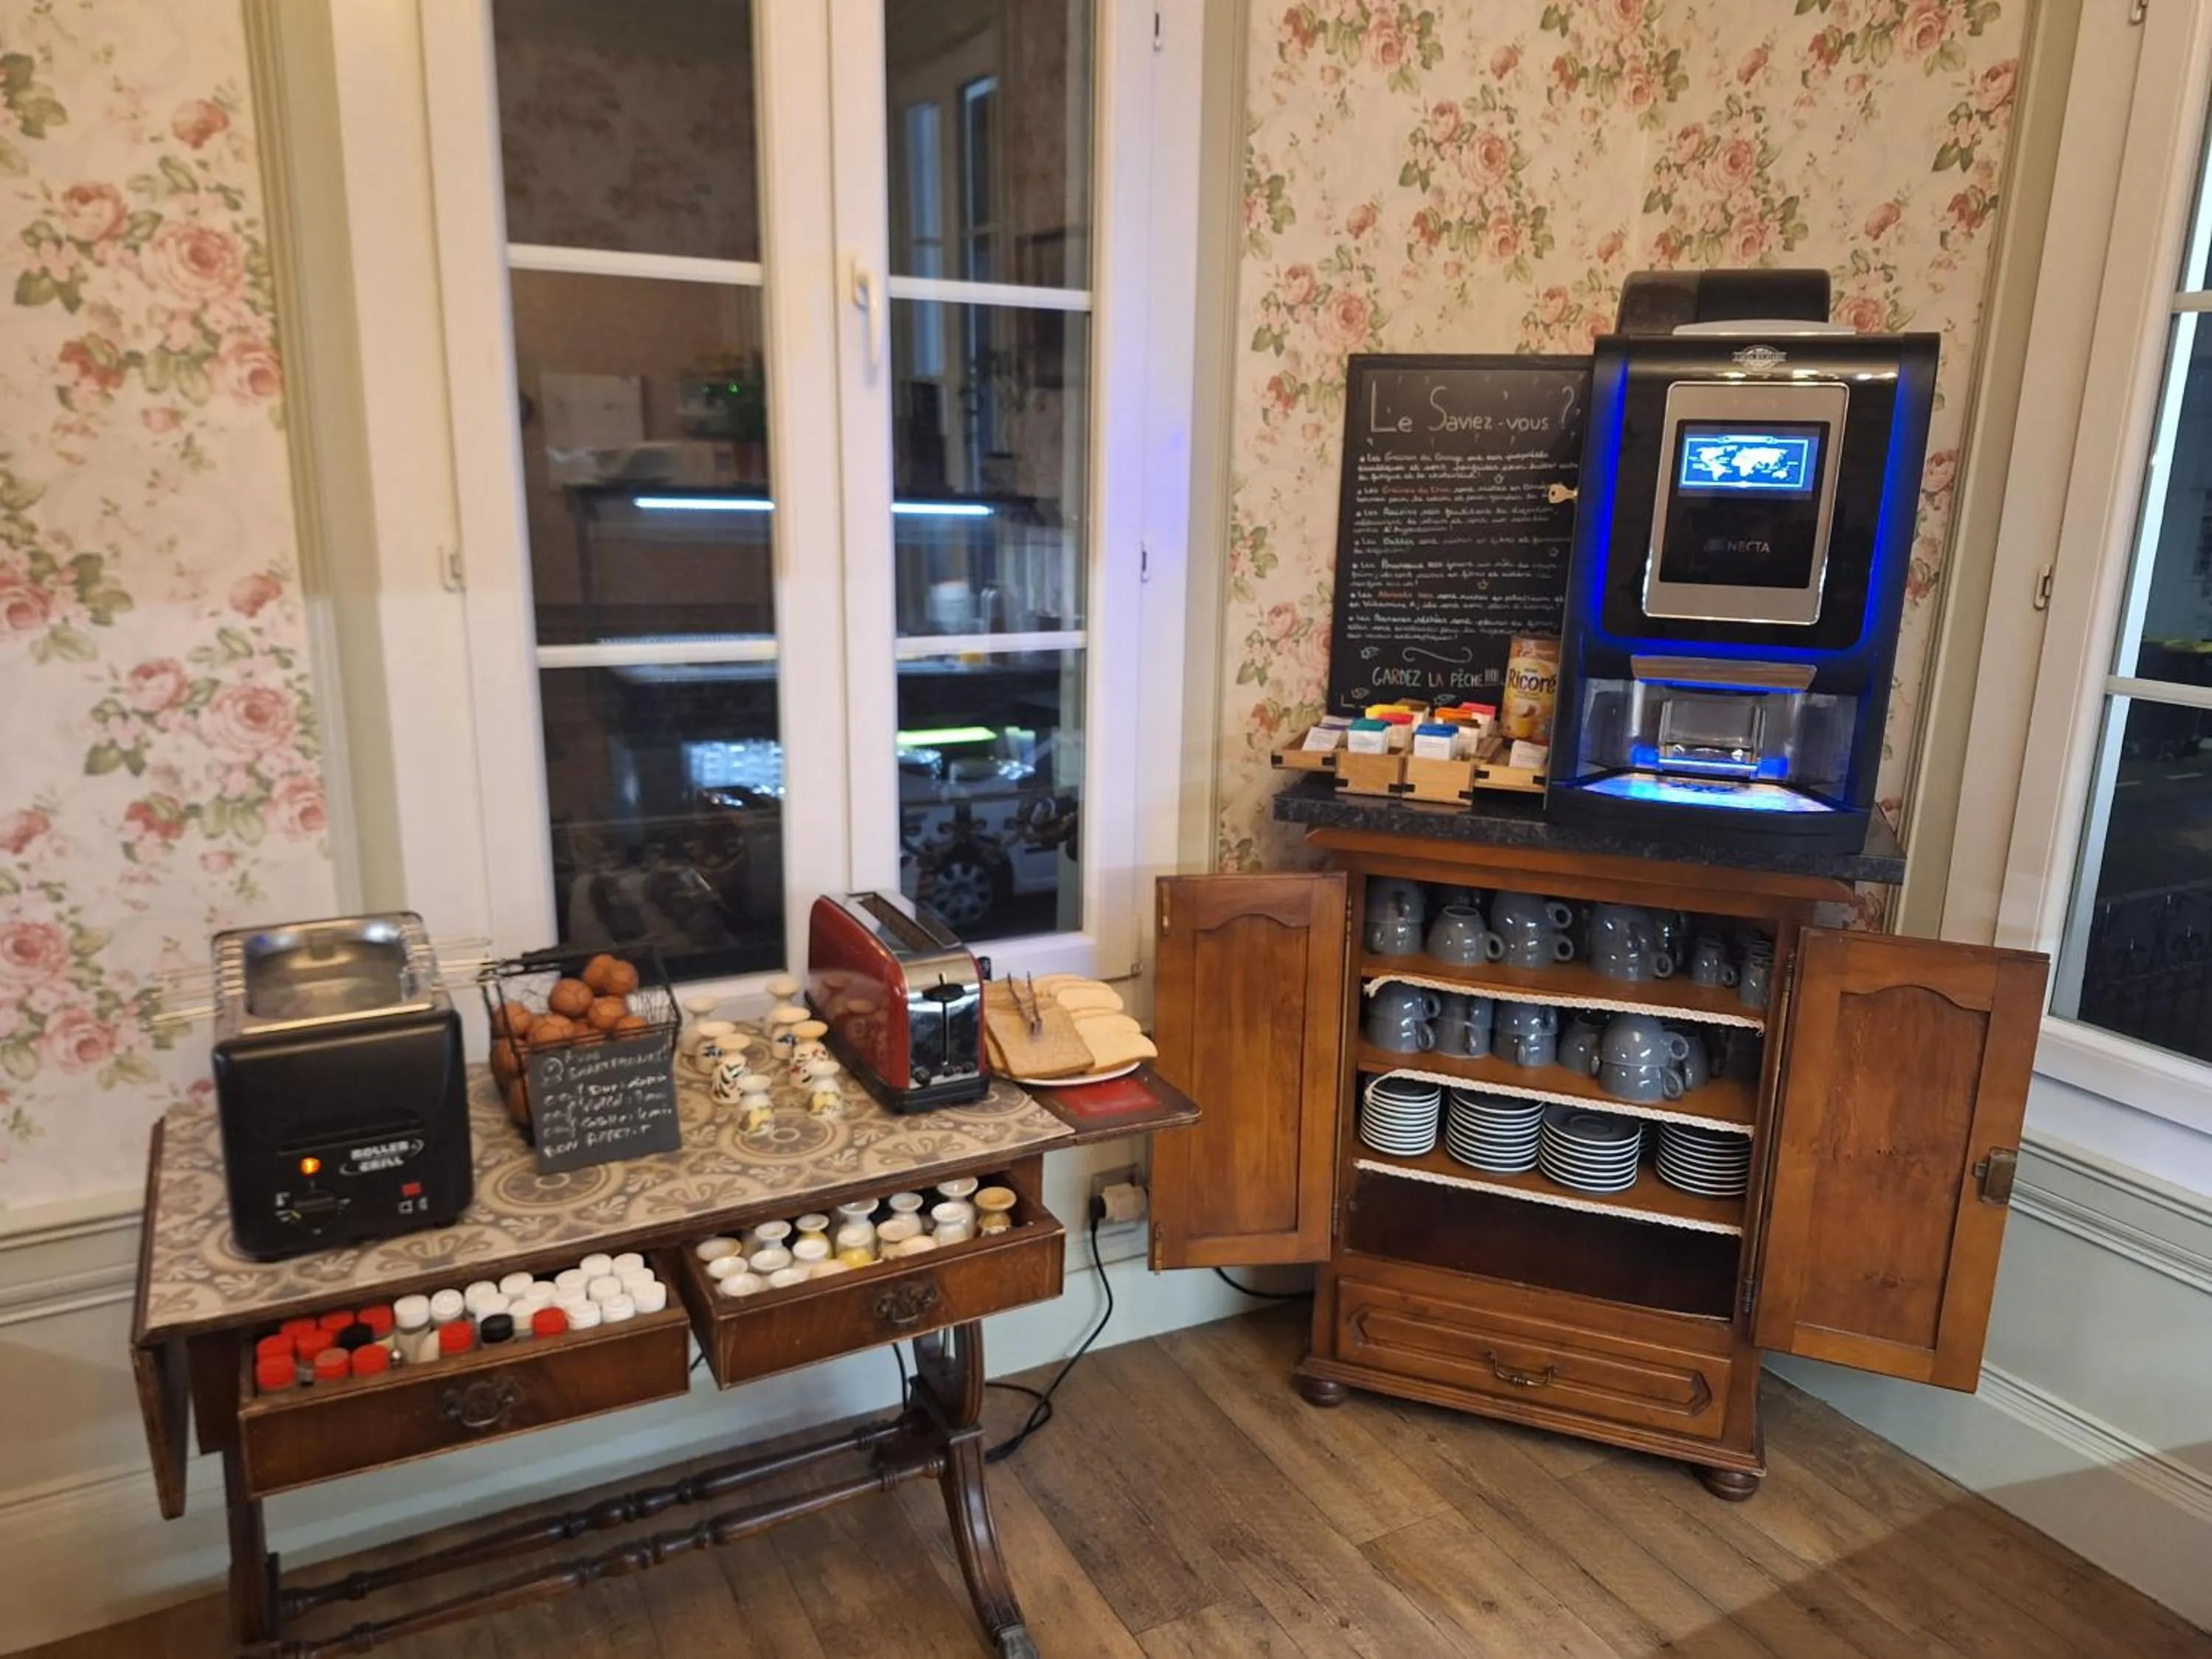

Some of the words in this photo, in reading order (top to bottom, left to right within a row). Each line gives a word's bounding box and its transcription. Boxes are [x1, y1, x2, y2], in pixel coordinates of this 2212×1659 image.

[1371, 380, 1413, 433] Le
[1727, 540, 1770, 553] NECTA
[1372, 667, 1422, 687] GARDEZ
[1428, 672, 1444, 688] LA
